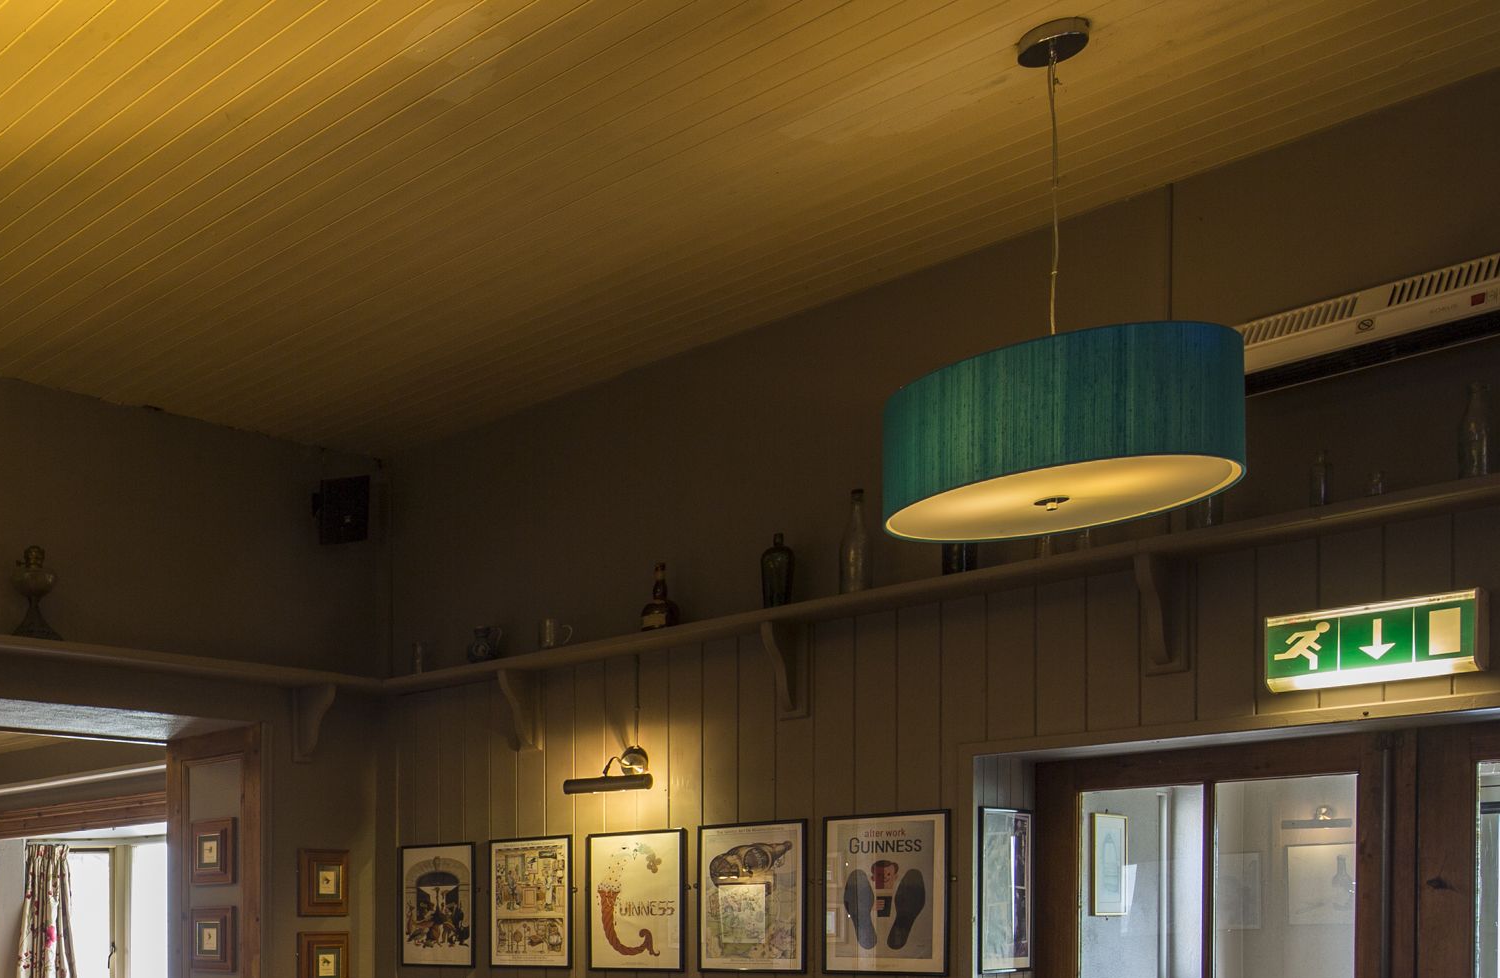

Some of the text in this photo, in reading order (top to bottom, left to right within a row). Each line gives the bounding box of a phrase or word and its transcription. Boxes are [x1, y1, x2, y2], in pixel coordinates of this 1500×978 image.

[864, 827, 906, 838] after work
[849, 837, 922, 854] GUINNESS
